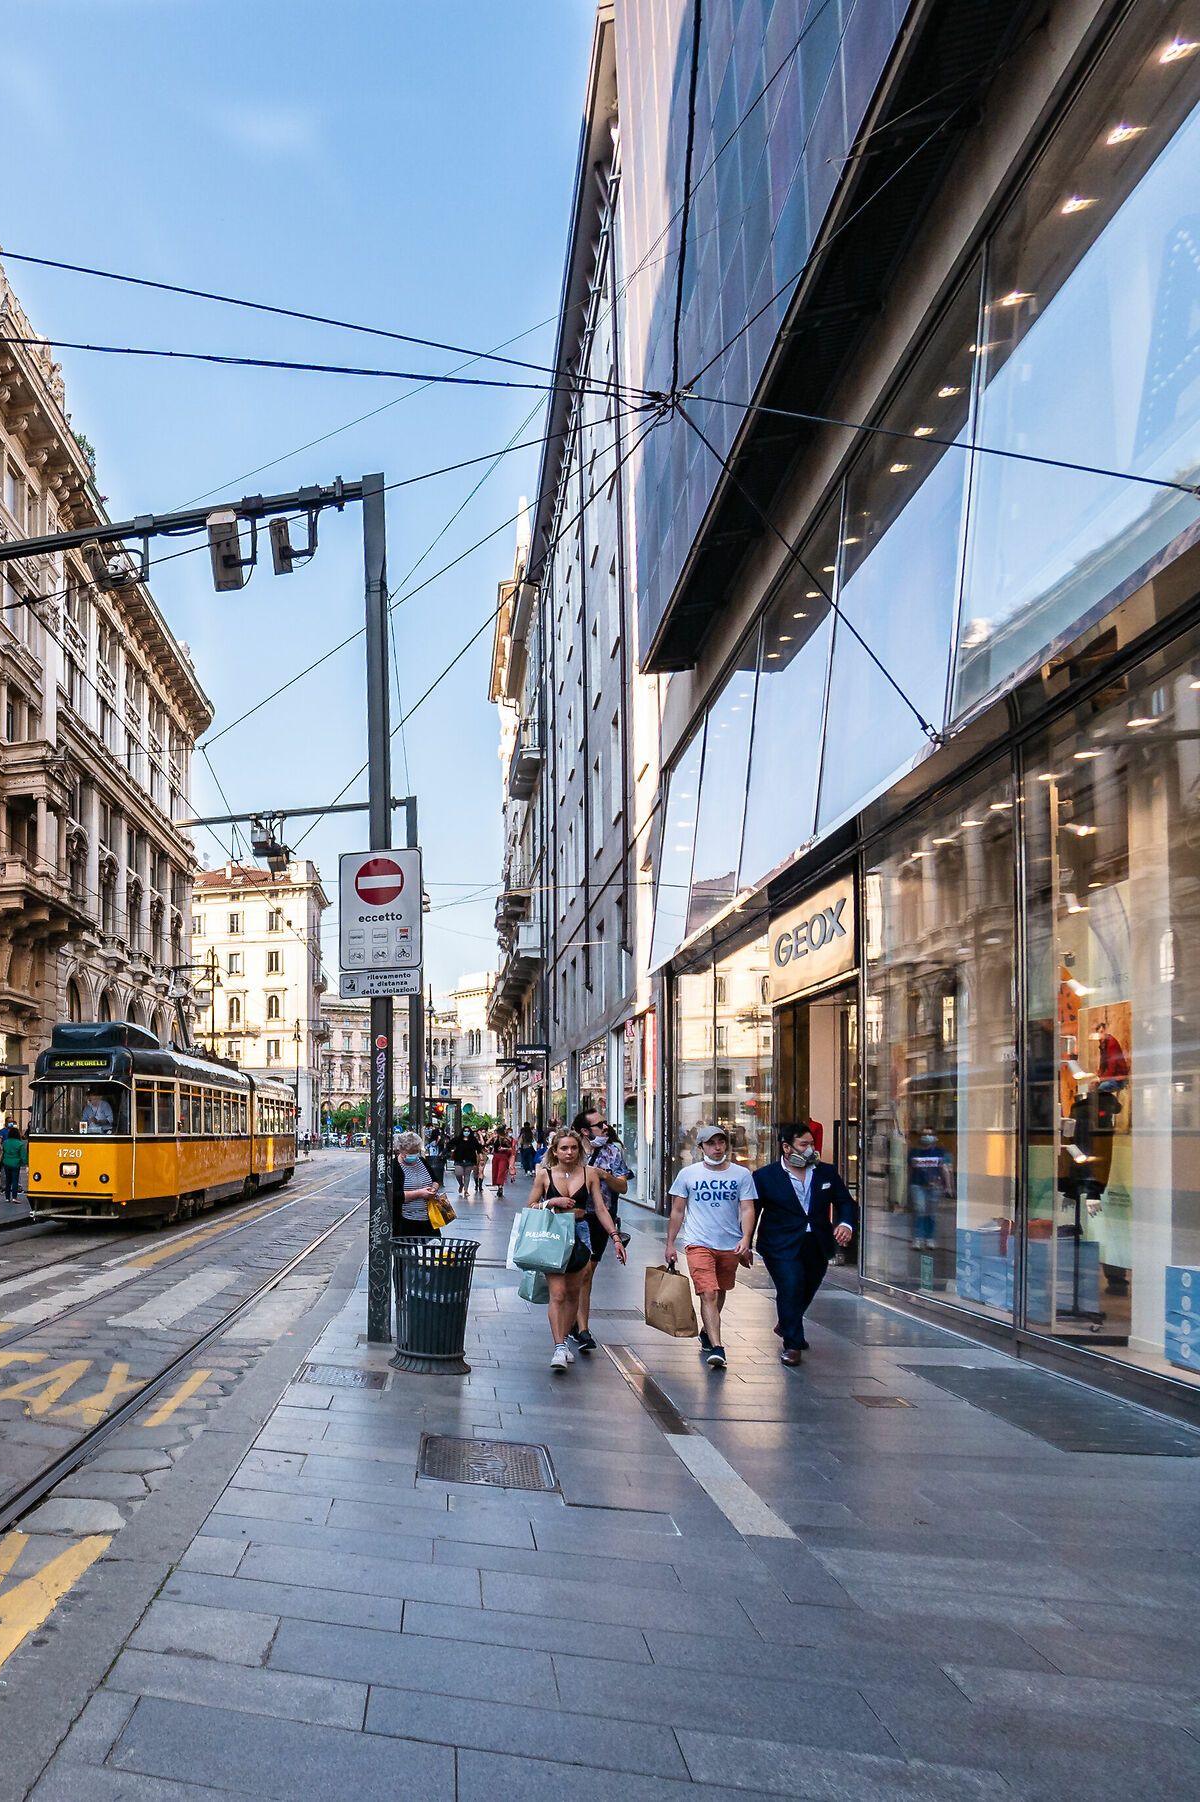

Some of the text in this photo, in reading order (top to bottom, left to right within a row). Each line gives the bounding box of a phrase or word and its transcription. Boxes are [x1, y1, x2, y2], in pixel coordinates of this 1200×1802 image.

[358, 912, 403, 922] eccetto
[775, 898, 846, 967] GEOX
[367, 972, 412, 980] rilevamento
[382, 986, 417, 994] violazioni
[57, 1149, 82, 1158] 4720
[694, 1191, 737, 1202] JONES
